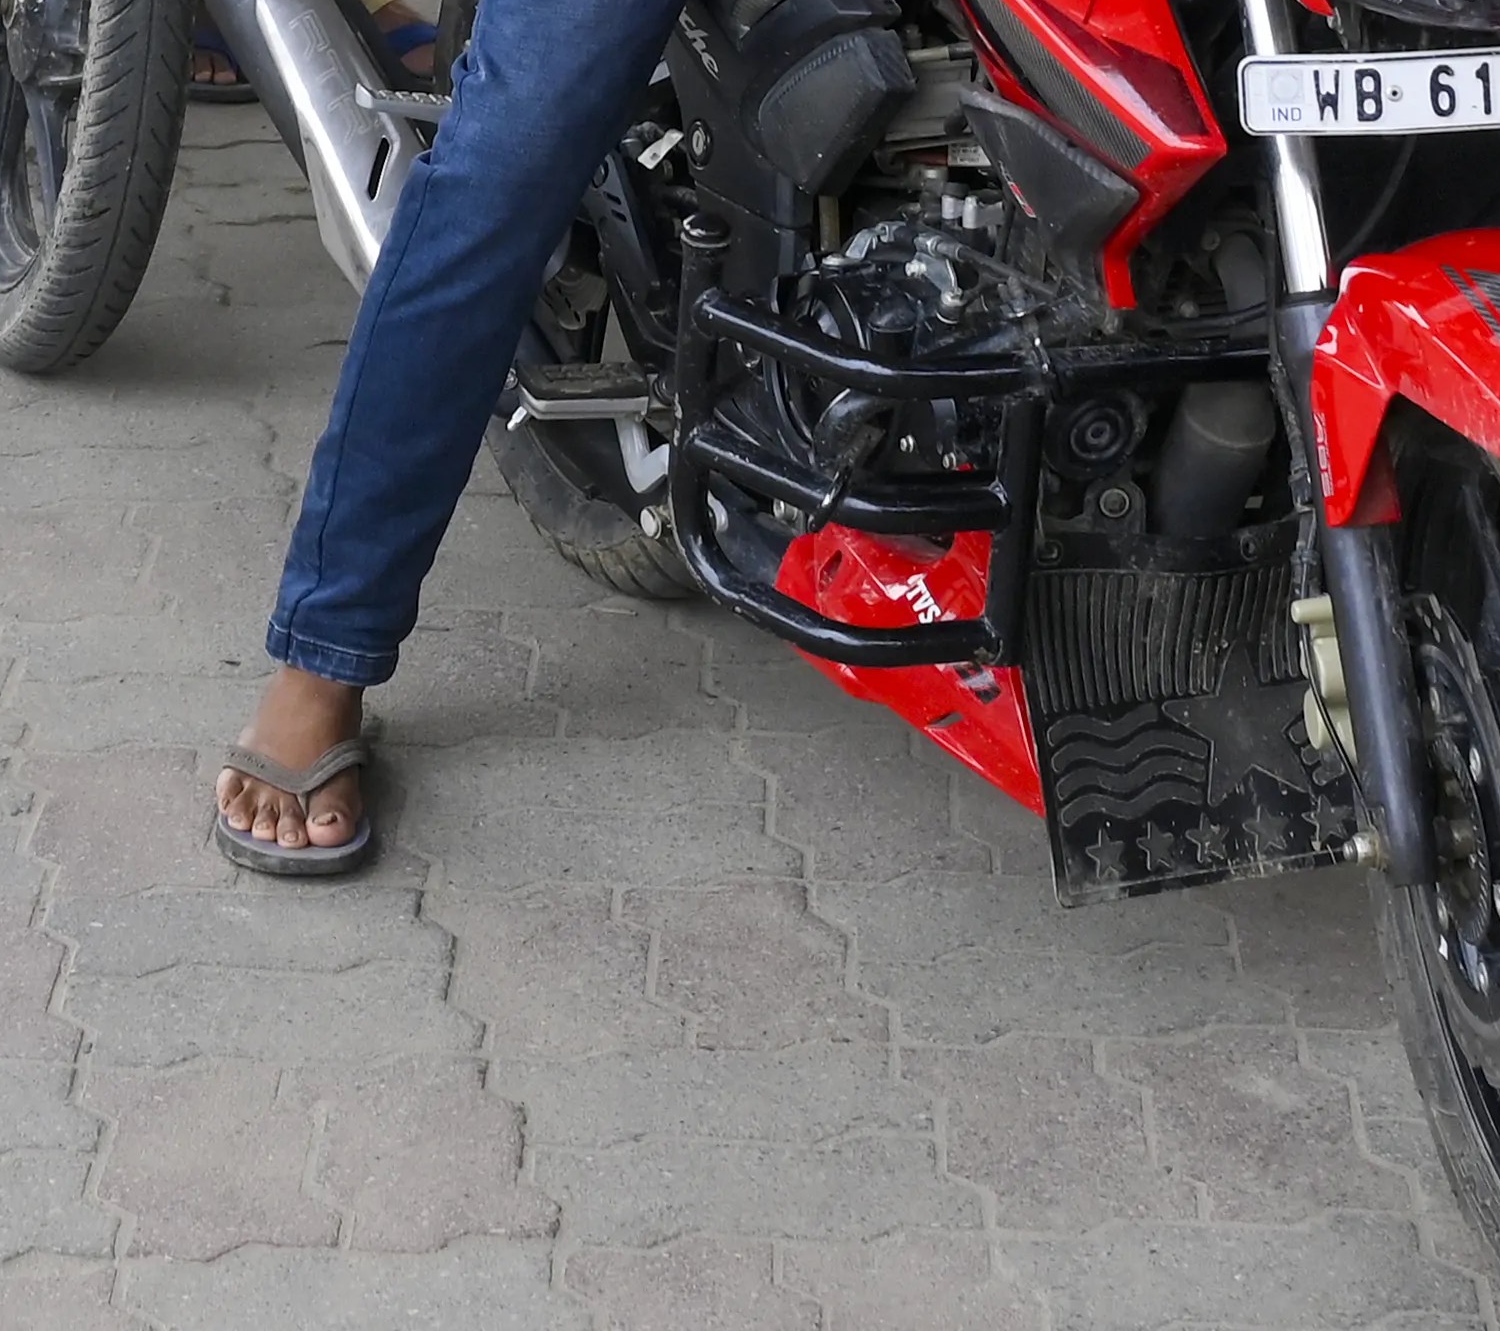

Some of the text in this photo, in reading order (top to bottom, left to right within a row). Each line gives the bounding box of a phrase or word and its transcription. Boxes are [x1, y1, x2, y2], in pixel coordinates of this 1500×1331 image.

[1270, 106, 1303, 123] IND
[1313, 67, 1383, 123] WB
[905, 572, 942, 625] TVS
